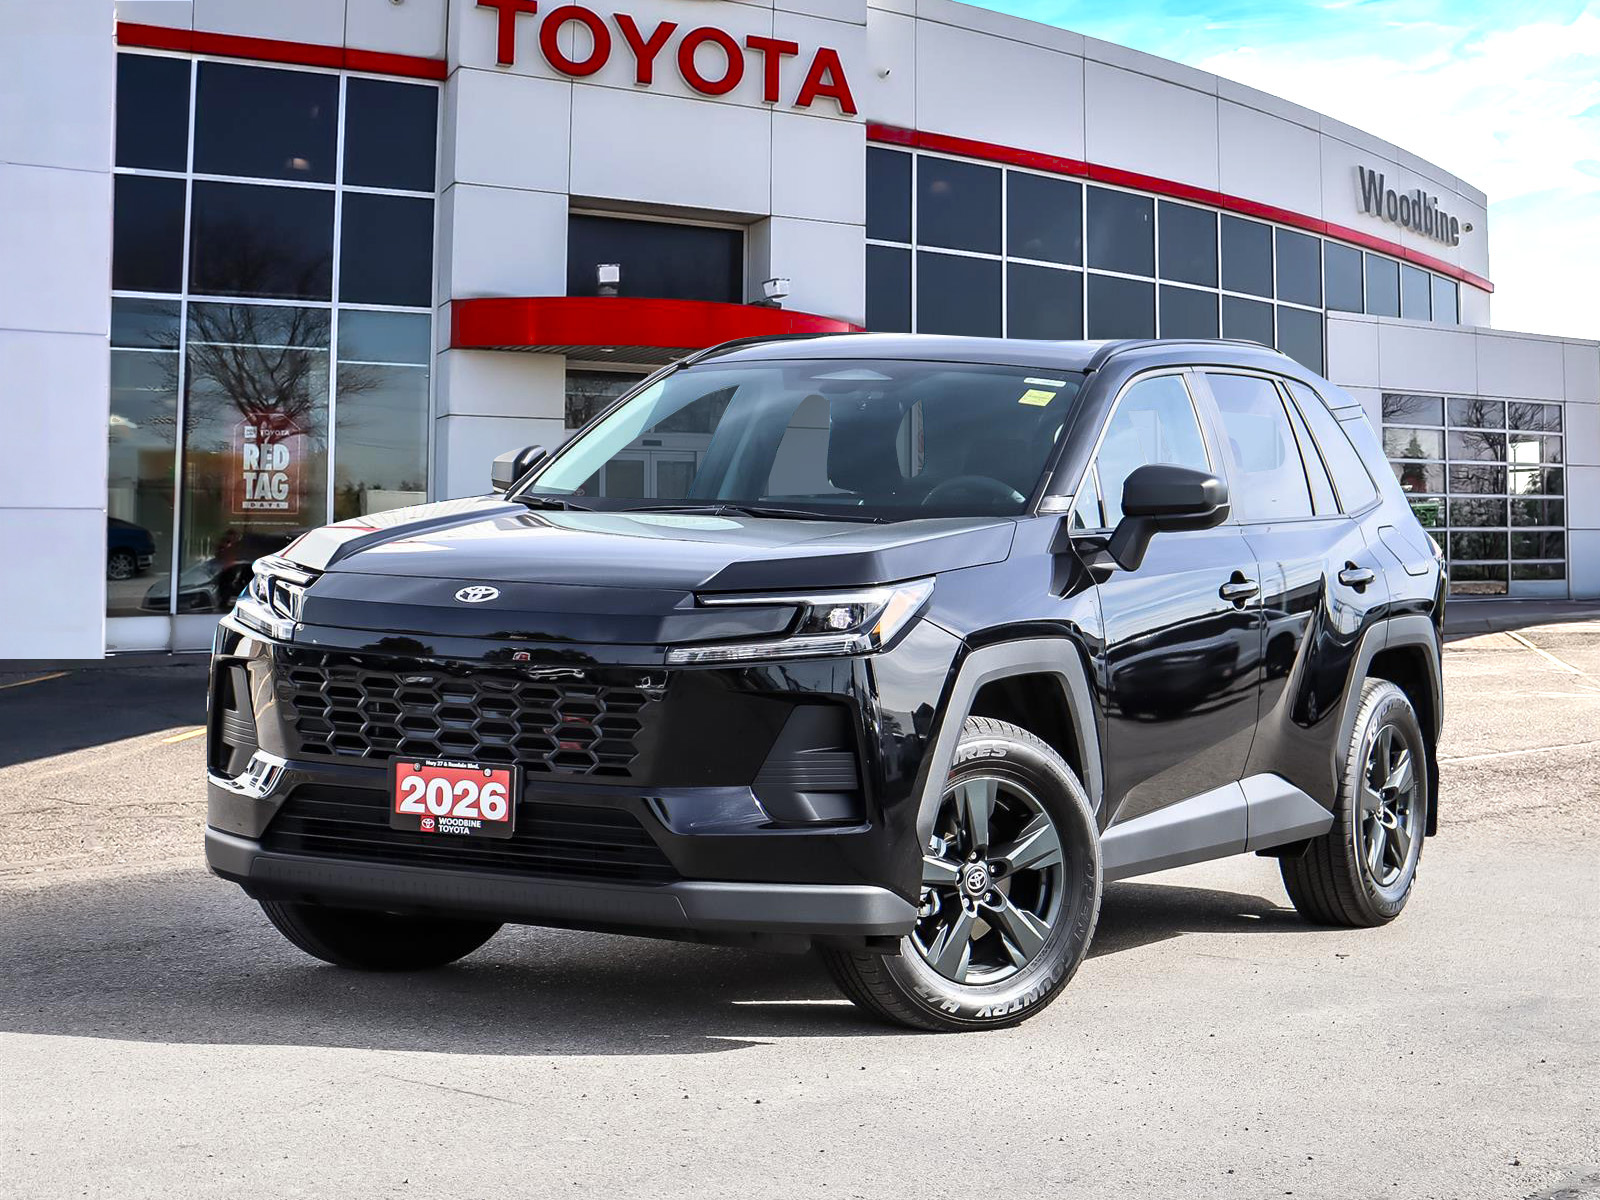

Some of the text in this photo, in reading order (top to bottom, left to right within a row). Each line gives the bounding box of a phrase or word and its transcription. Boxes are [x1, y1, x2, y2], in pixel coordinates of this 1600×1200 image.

[476, 0, 858, 117] TOYOTA
[1356, 164, 1460, 247] Woodbine
[242, 443, 290, 472] RED
[242, 472, 289, 501] TAG
[400, 776, 507, 820] 2026
[438, 817, 481, 828] WOODBINE
[438, 824, 470, 835] TOYOTA
[974, 949, 1074, 1018] COUNTRY
[913, 985, 961, 1014] H/T
